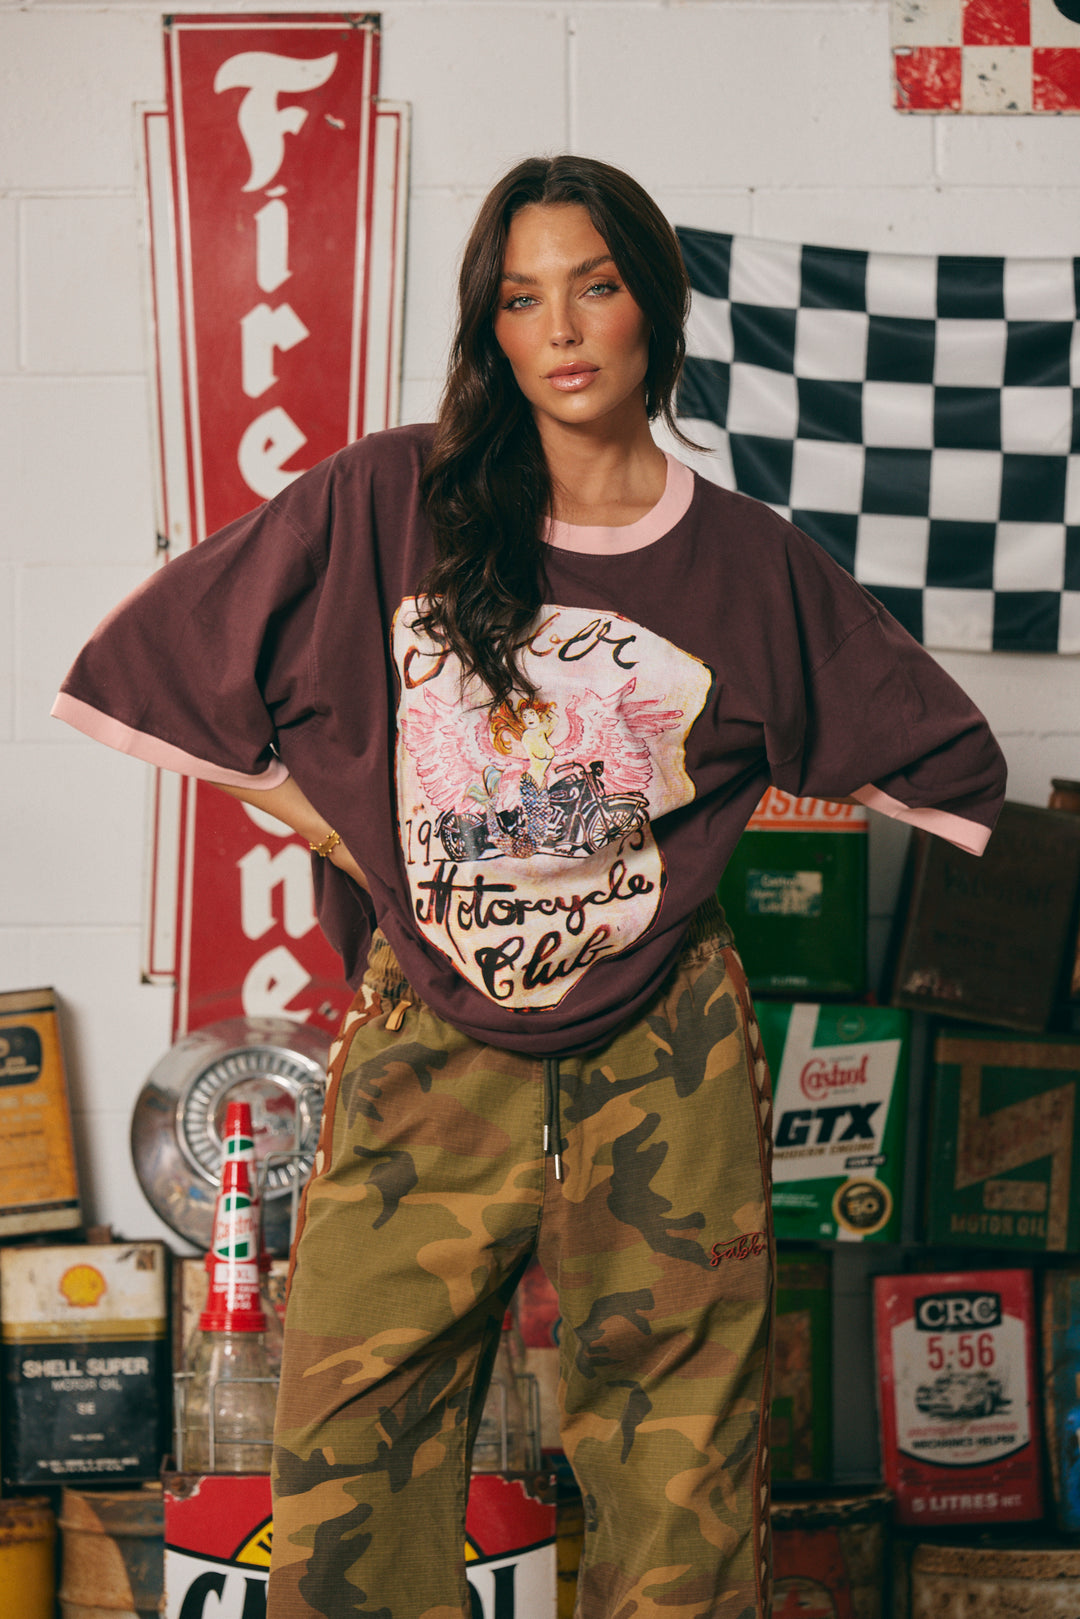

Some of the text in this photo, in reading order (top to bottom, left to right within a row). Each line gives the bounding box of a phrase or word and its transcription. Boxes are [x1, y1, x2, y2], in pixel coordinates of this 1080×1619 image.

[405, 819, 432, 867] 19
[416, 858, 655, 964] Motorcycle
[474, 924, 614, 1001] Club
[800, 1053, 869, 1101] Castrol
[774, 1101, 882, 1148] GTX
[950, 1213, 1047, 1238] MOTOR OIL
[920, 1296, 998, 1327] CRC
[22, 1356, 149, 1378] SHELL SUPER
[51, 1377, 123, 1392] MOTOR OIL
[929, 1493, 999, 1511] LITRES
